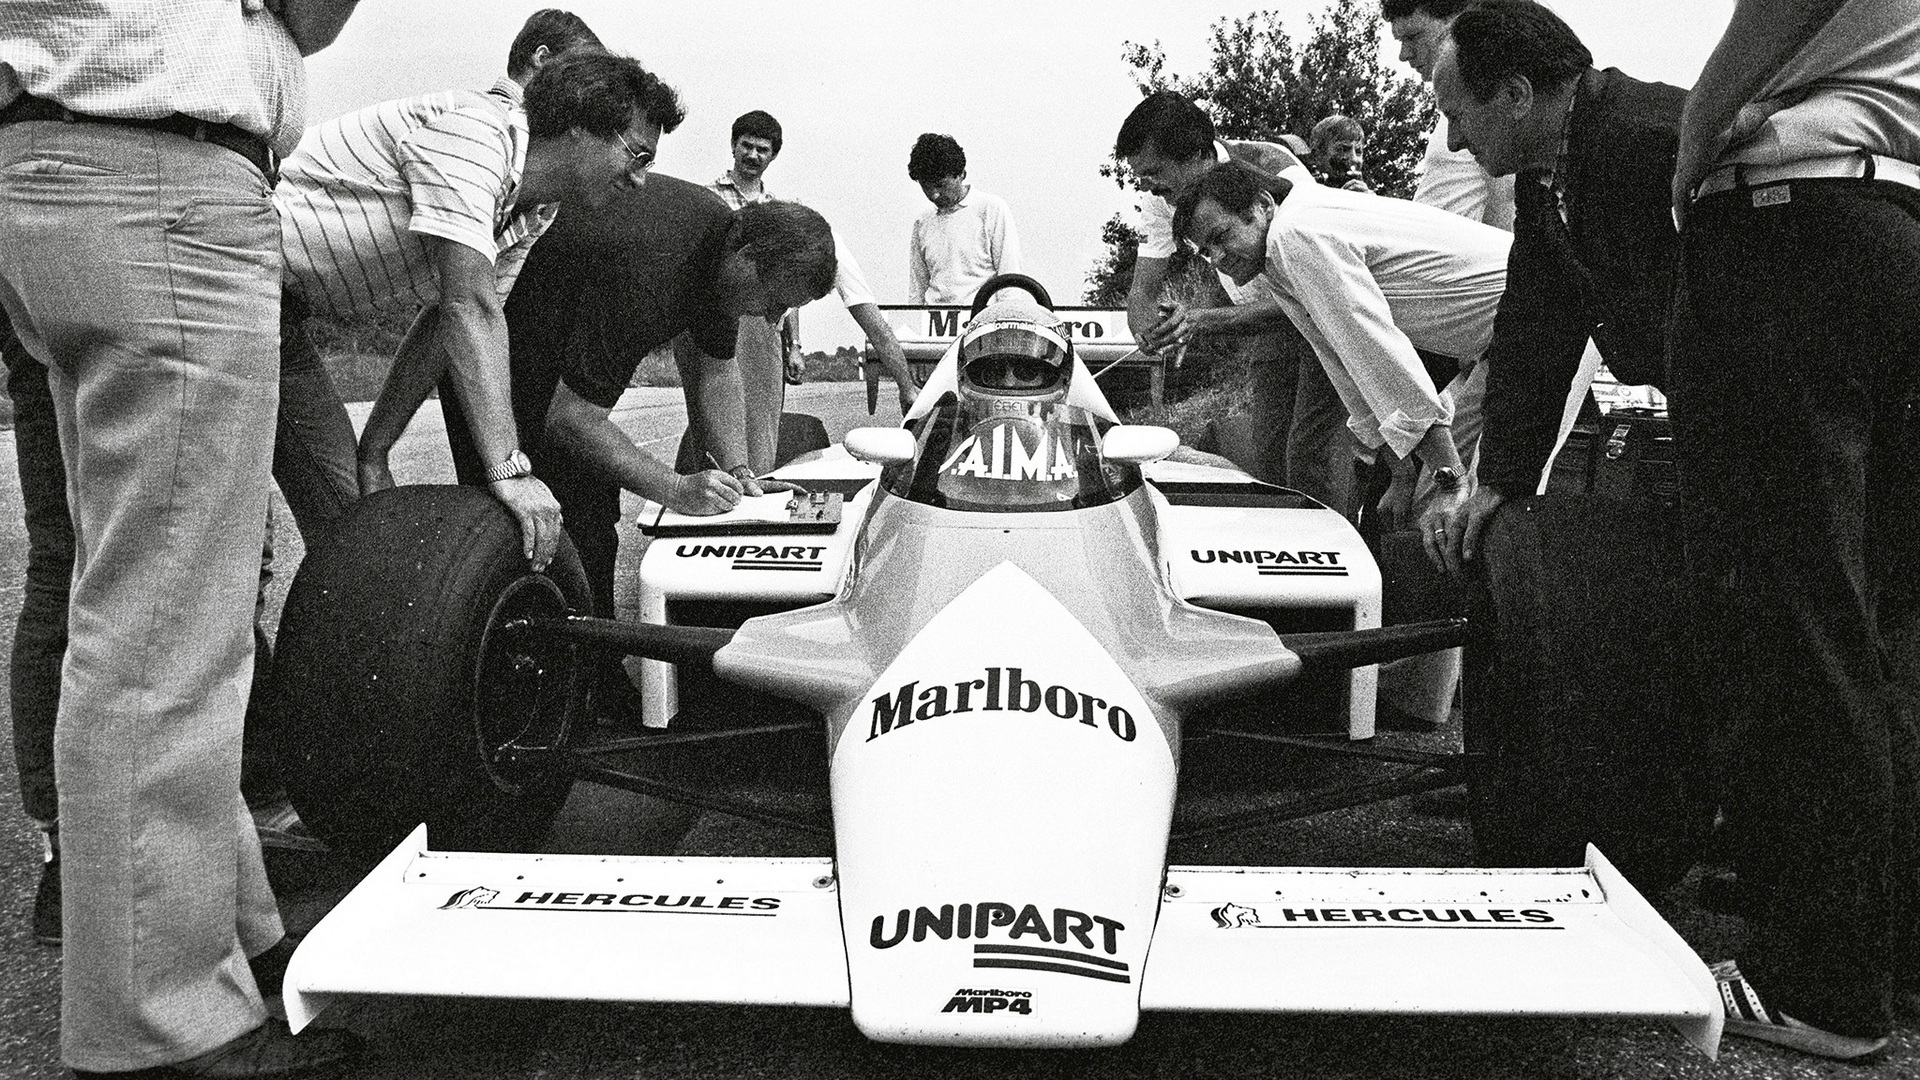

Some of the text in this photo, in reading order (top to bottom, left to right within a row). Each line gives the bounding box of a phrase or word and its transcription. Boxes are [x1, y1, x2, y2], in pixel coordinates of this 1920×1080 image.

[676, 545, 827, 560] UNIPART
[1191, 549, 1341, 565] UNIPART
[866, 667, 1137, 743] Marlboro
[515, 891, 781, 911] HERCULES
[1284, 908, 1555, 923] HERCULES
[870, 902, 1125, 955] UNIPART
[955, 988, 1032, 998] Marlboro
[941, 996, 1032, 1015] MP4
